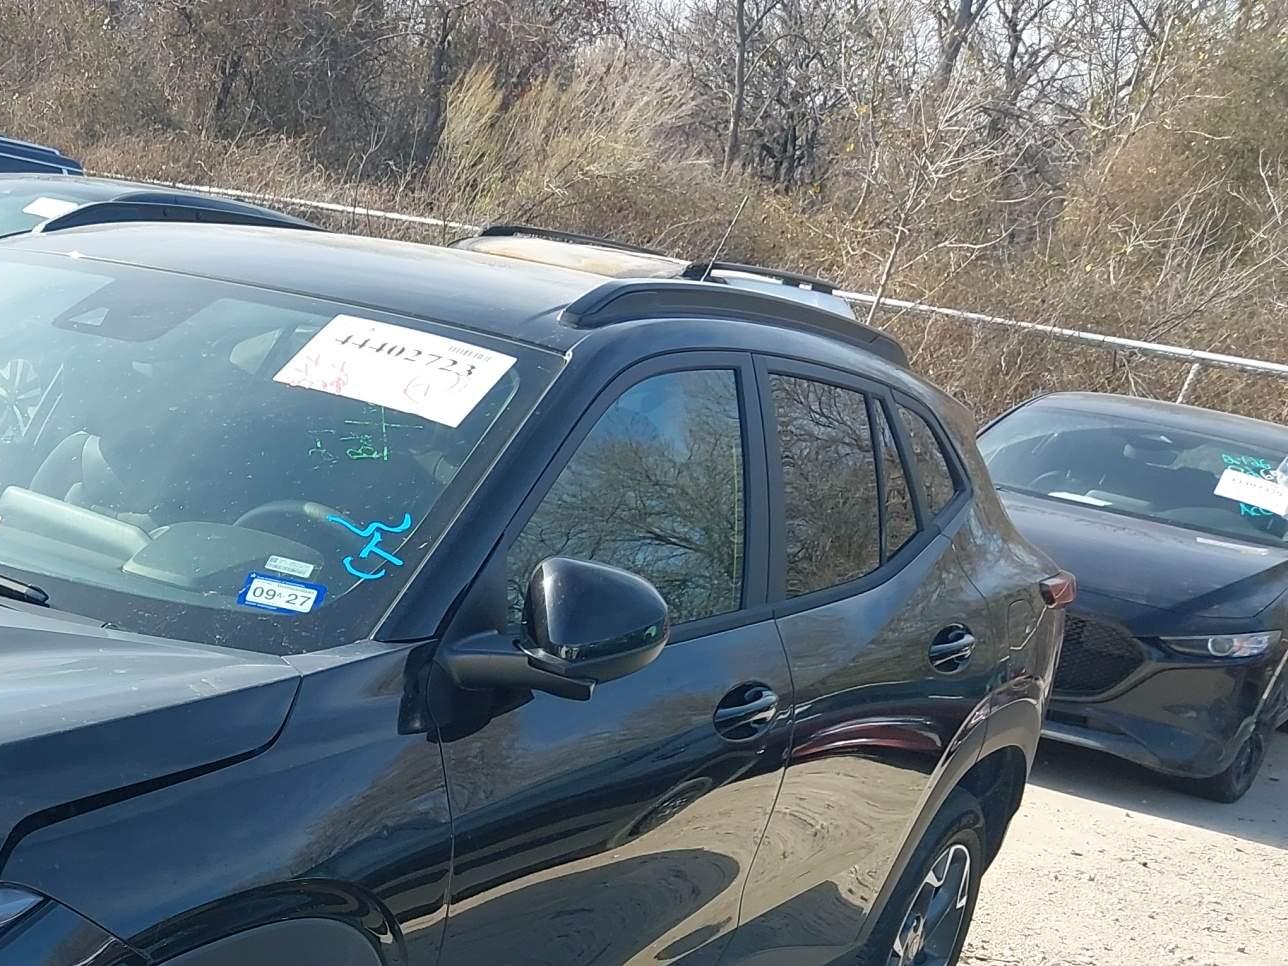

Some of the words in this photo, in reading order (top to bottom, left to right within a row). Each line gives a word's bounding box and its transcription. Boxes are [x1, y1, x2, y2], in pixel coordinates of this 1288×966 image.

[334, 334, 478, 379] 44402723
[252, 586, 277, 601] 09
[284, 592, 312, 607] 27
